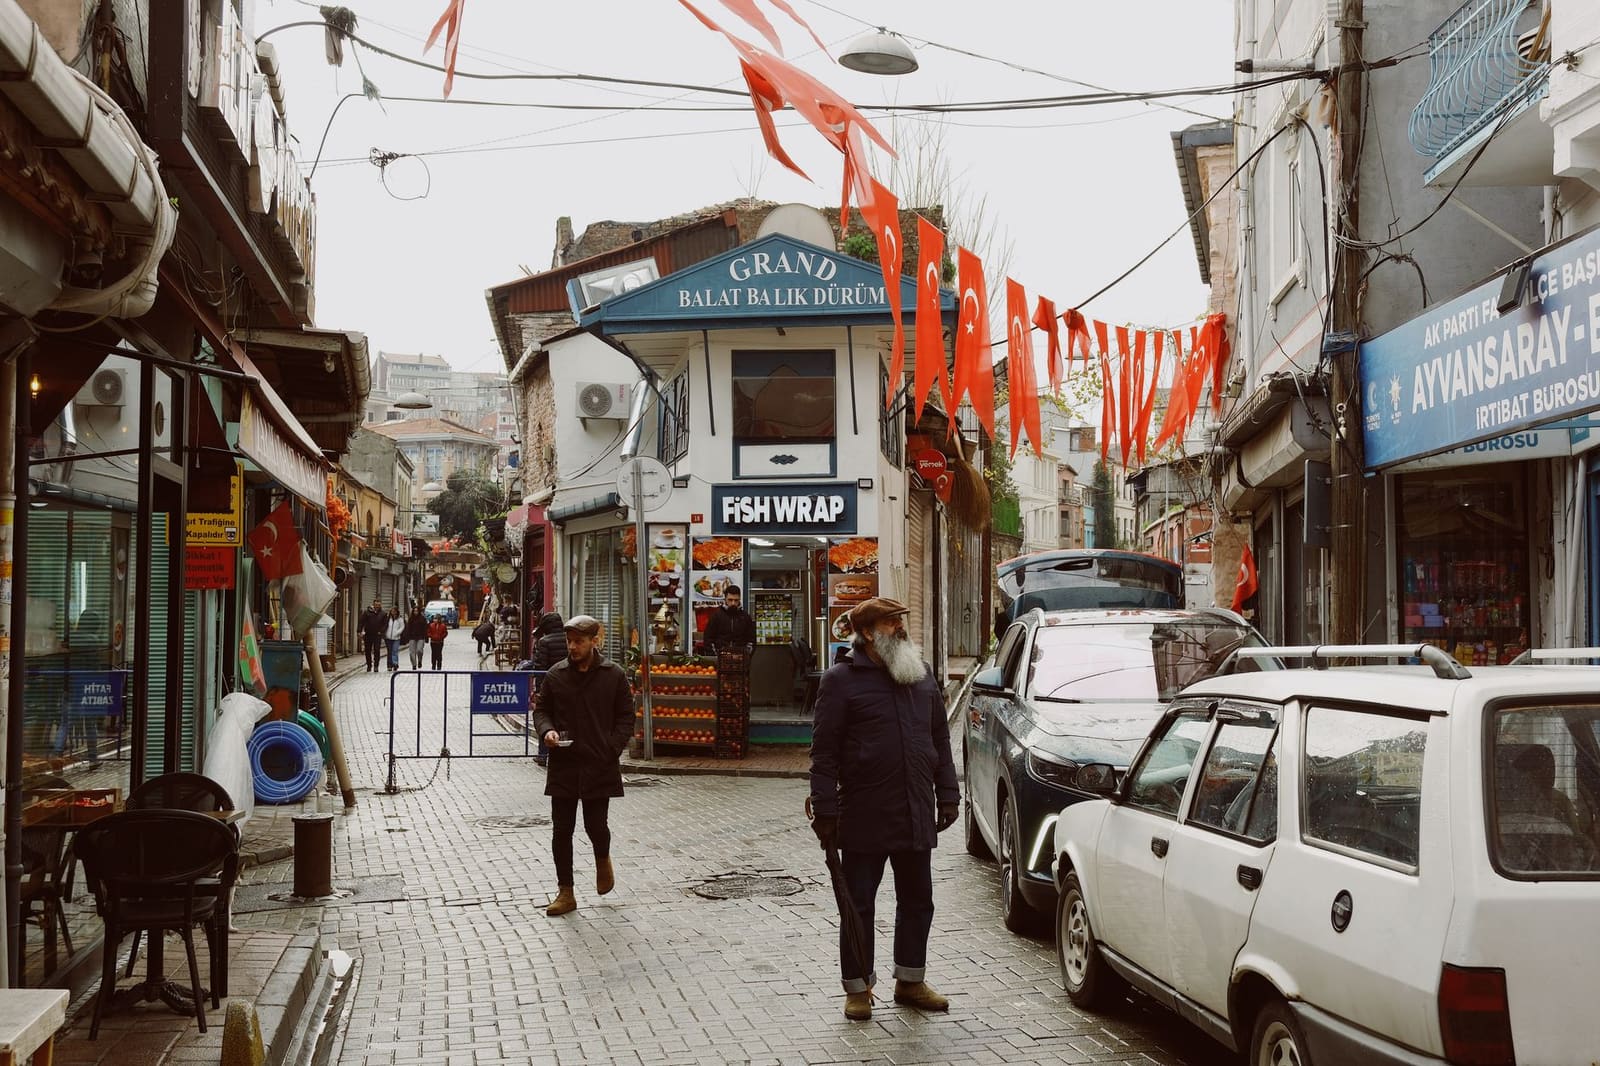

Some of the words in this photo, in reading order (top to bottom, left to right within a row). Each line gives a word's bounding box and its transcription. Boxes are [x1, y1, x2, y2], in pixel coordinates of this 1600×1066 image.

[729, 251, 837, 282] GRAND
[679, 288, 742, 308] BALAT
[747, 287, 809, 306] BALIK
[814, 283, 886, 305] DÜRÜM
[1424, 322, 1441, 350] AK
[1411, 304, 1573, 415] AYVANSARAY
[1475, 392, 1530, 431] İRTİBAT
[1533, 369, 1600, 414] BÜROSU
[919, 460, 944, 469] yemek
[773, 495, 845, 523] WRAP
[199, 518, 235, 528] Trafiğine
[480, 695, 519, 704] ZABITA
[484, 681, 516, 693] FATİH
